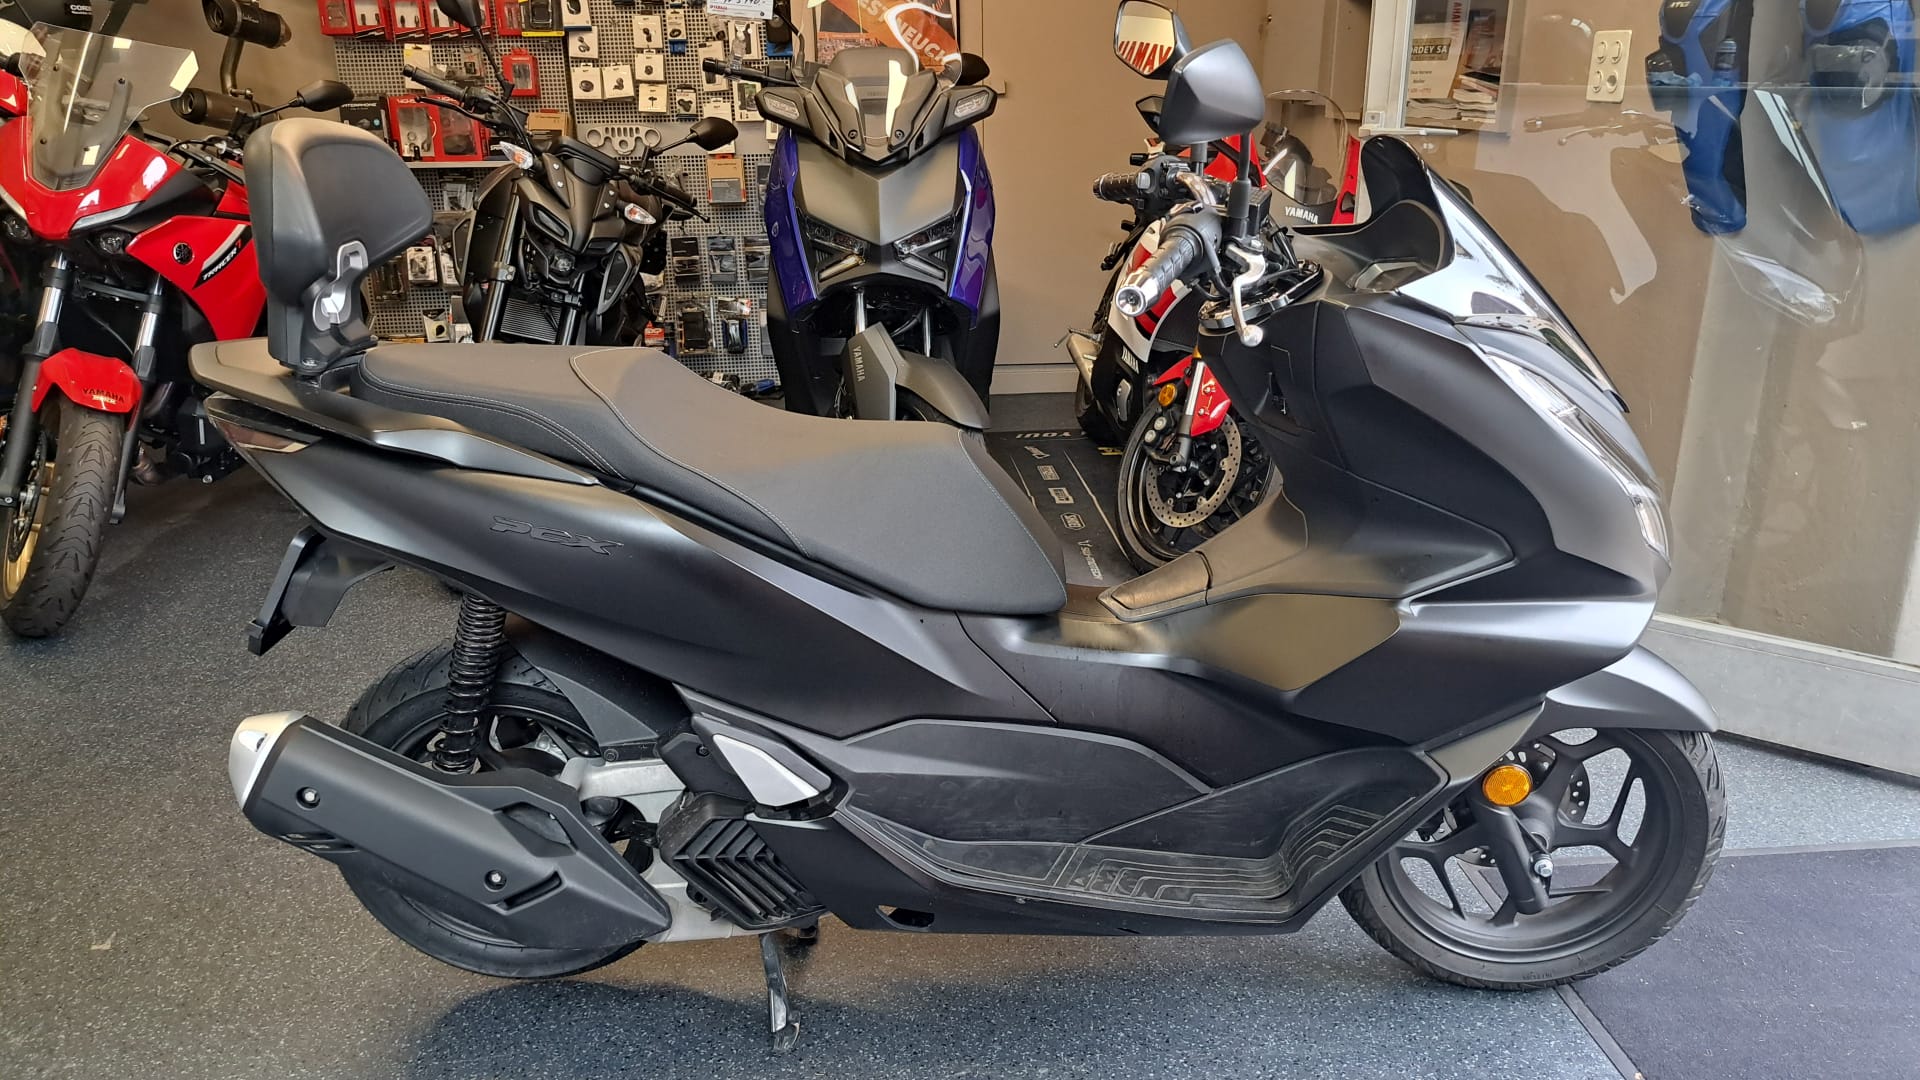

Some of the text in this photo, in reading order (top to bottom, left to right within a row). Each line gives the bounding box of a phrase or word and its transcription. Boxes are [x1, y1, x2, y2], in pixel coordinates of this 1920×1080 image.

[1411, 45, 1435, 54] RDEY
[1285, 206, 1319, 224] YAMAHA
[203, 247, 237, 280] TRACER
[853, 345, 866, 382] YAMAHA
[82, 388, 125, 403] YAMAHA
[489, 515, 625, 556] PCX
